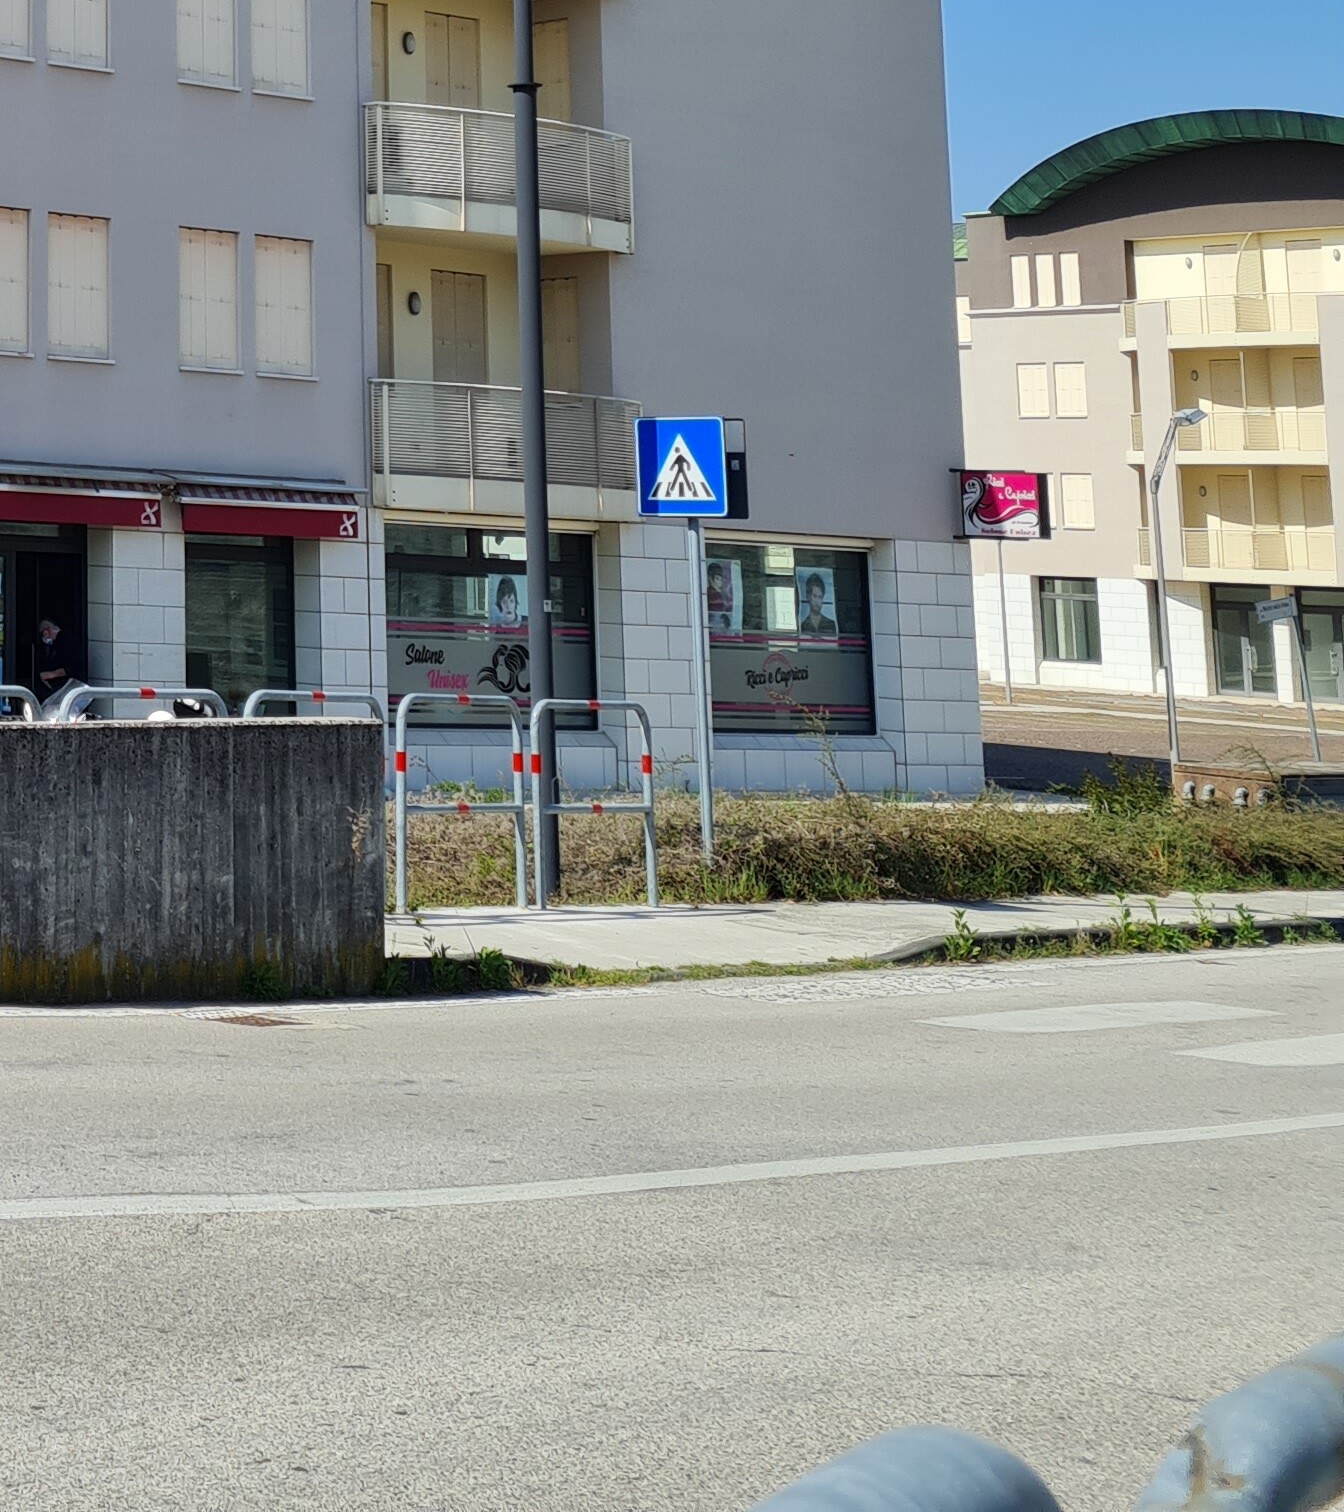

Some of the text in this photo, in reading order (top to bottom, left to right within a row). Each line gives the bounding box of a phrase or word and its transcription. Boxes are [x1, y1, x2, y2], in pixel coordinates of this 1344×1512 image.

[405, 643, 446, 665] Salone
[427, 669, 470, 689] Unisex
[745, 669, 766, 689] Ricci
[775, 666, 809, 687] Capricci
